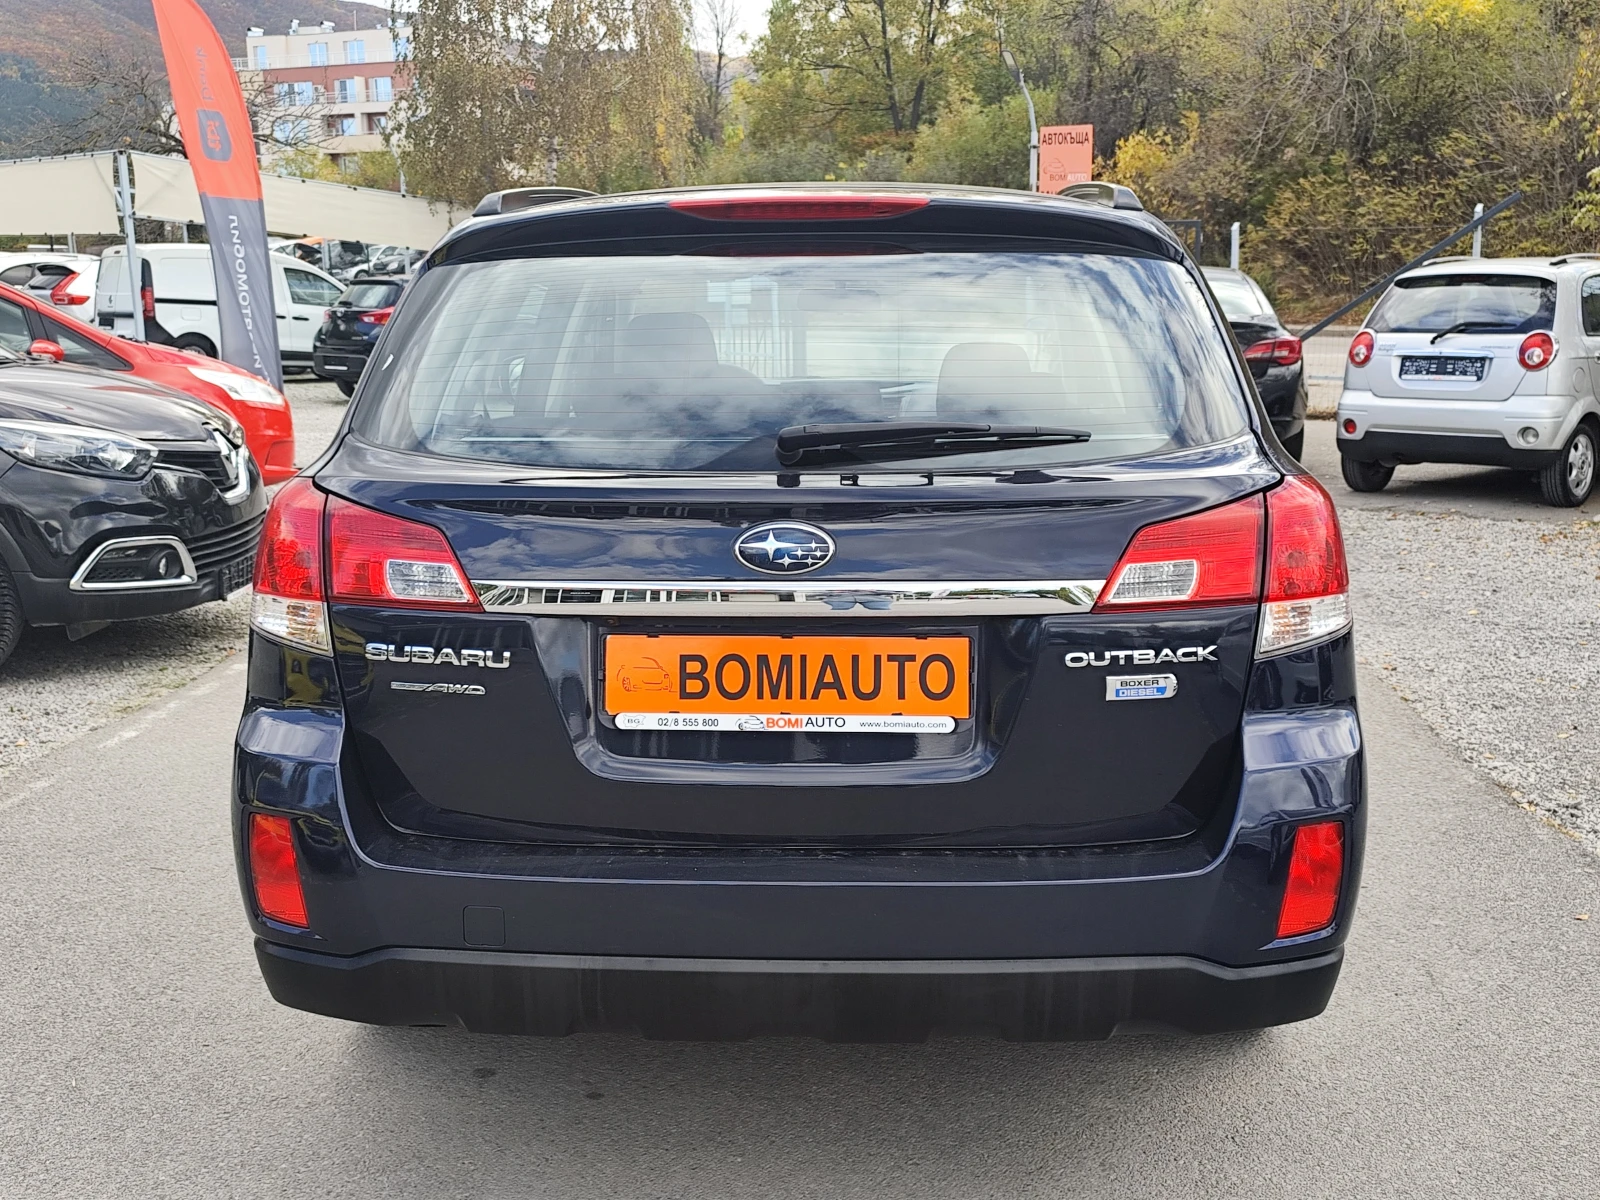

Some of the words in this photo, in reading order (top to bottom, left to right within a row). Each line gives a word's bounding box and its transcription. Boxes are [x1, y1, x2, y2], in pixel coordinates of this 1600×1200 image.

[1042, 131, 1090, 147] АВТОКЪЩА
[364, 642, 512, 669] SUBARU
[1064, 645, 1219, 668] OUTBACK
[679, 653, 956, 701] BOMIAUTO
[1120, 678, 1160, 688] BOXER
[425, 683, 486, 695] AWD
[1118, 687, 1162, 697] DIESEL
[657, 717, 679, 728] 02/8
[682, 718, 699, 727] 555
[702, 718, 719, 728] 800
[859, 720, 947, 729] www.bomiauto.com
